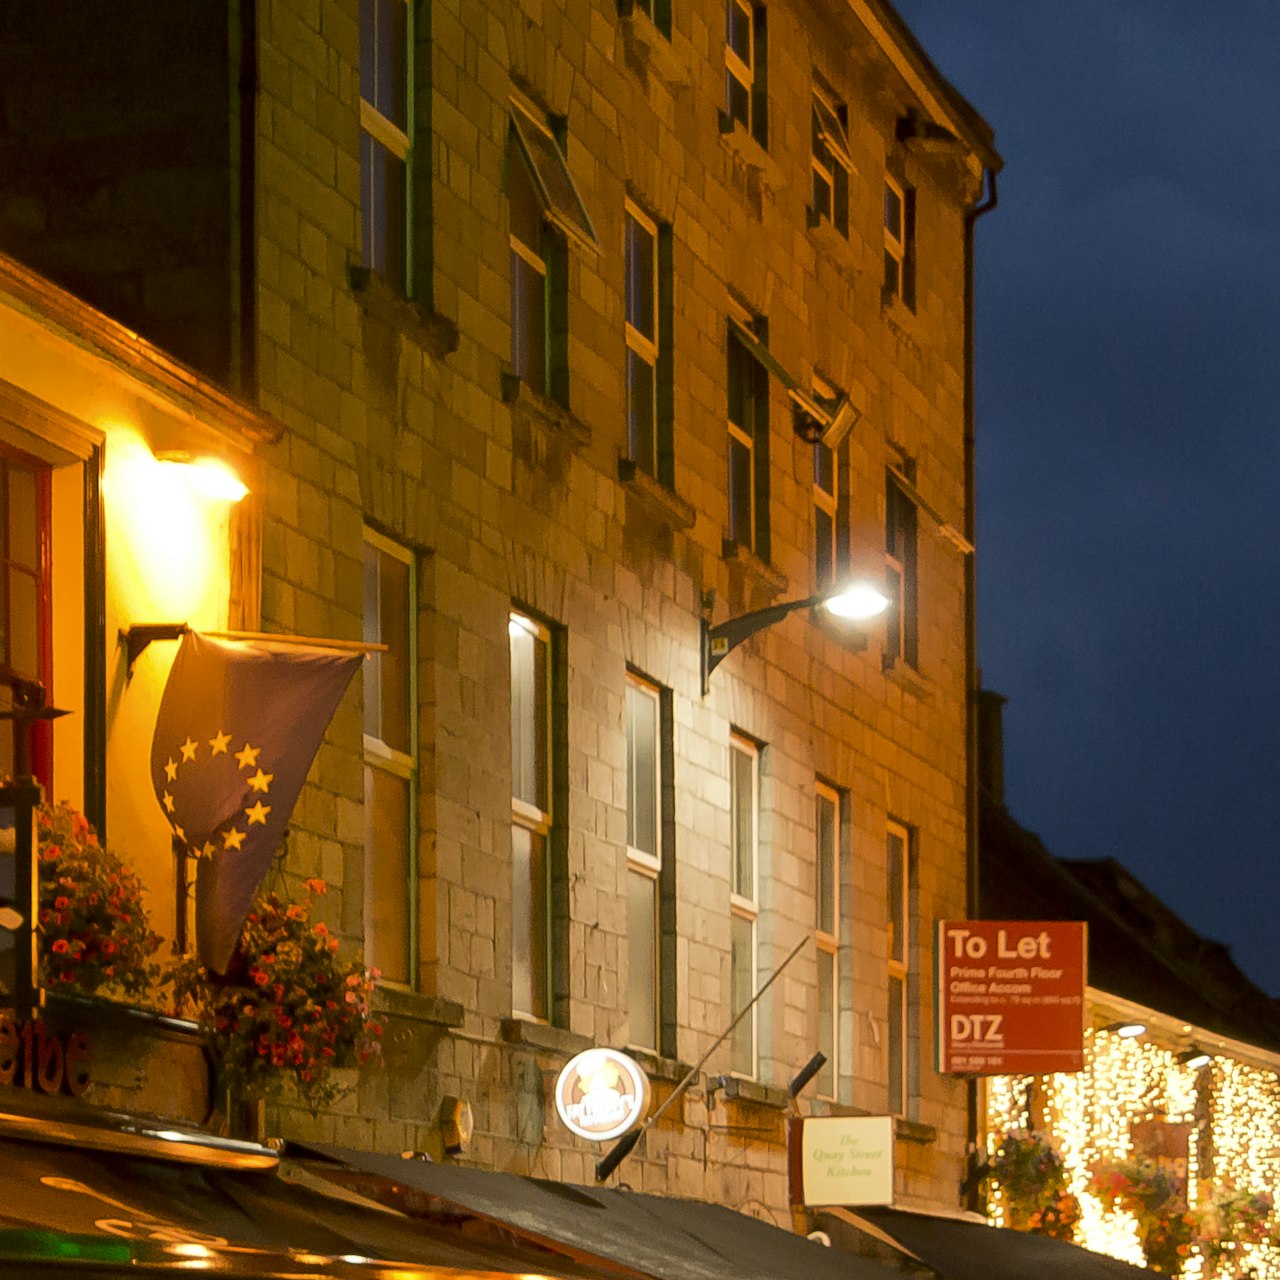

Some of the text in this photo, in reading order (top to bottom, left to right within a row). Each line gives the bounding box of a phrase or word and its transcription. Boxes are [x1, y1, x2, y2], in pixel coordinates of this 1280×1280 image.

[947, 929, 1052, 960] To Let
[950, 967, 986, 978] Prime
[1030, 967, 1063, 979] Floor
[950, 981, 987, 994] Office
[951, 1014, 1004, 1041] DTZ
[840, 1134, 858, 1146] The
[813, 1148, 883, 1163] Quay Street
[826, 1166, 872, 1177] Kitchen
